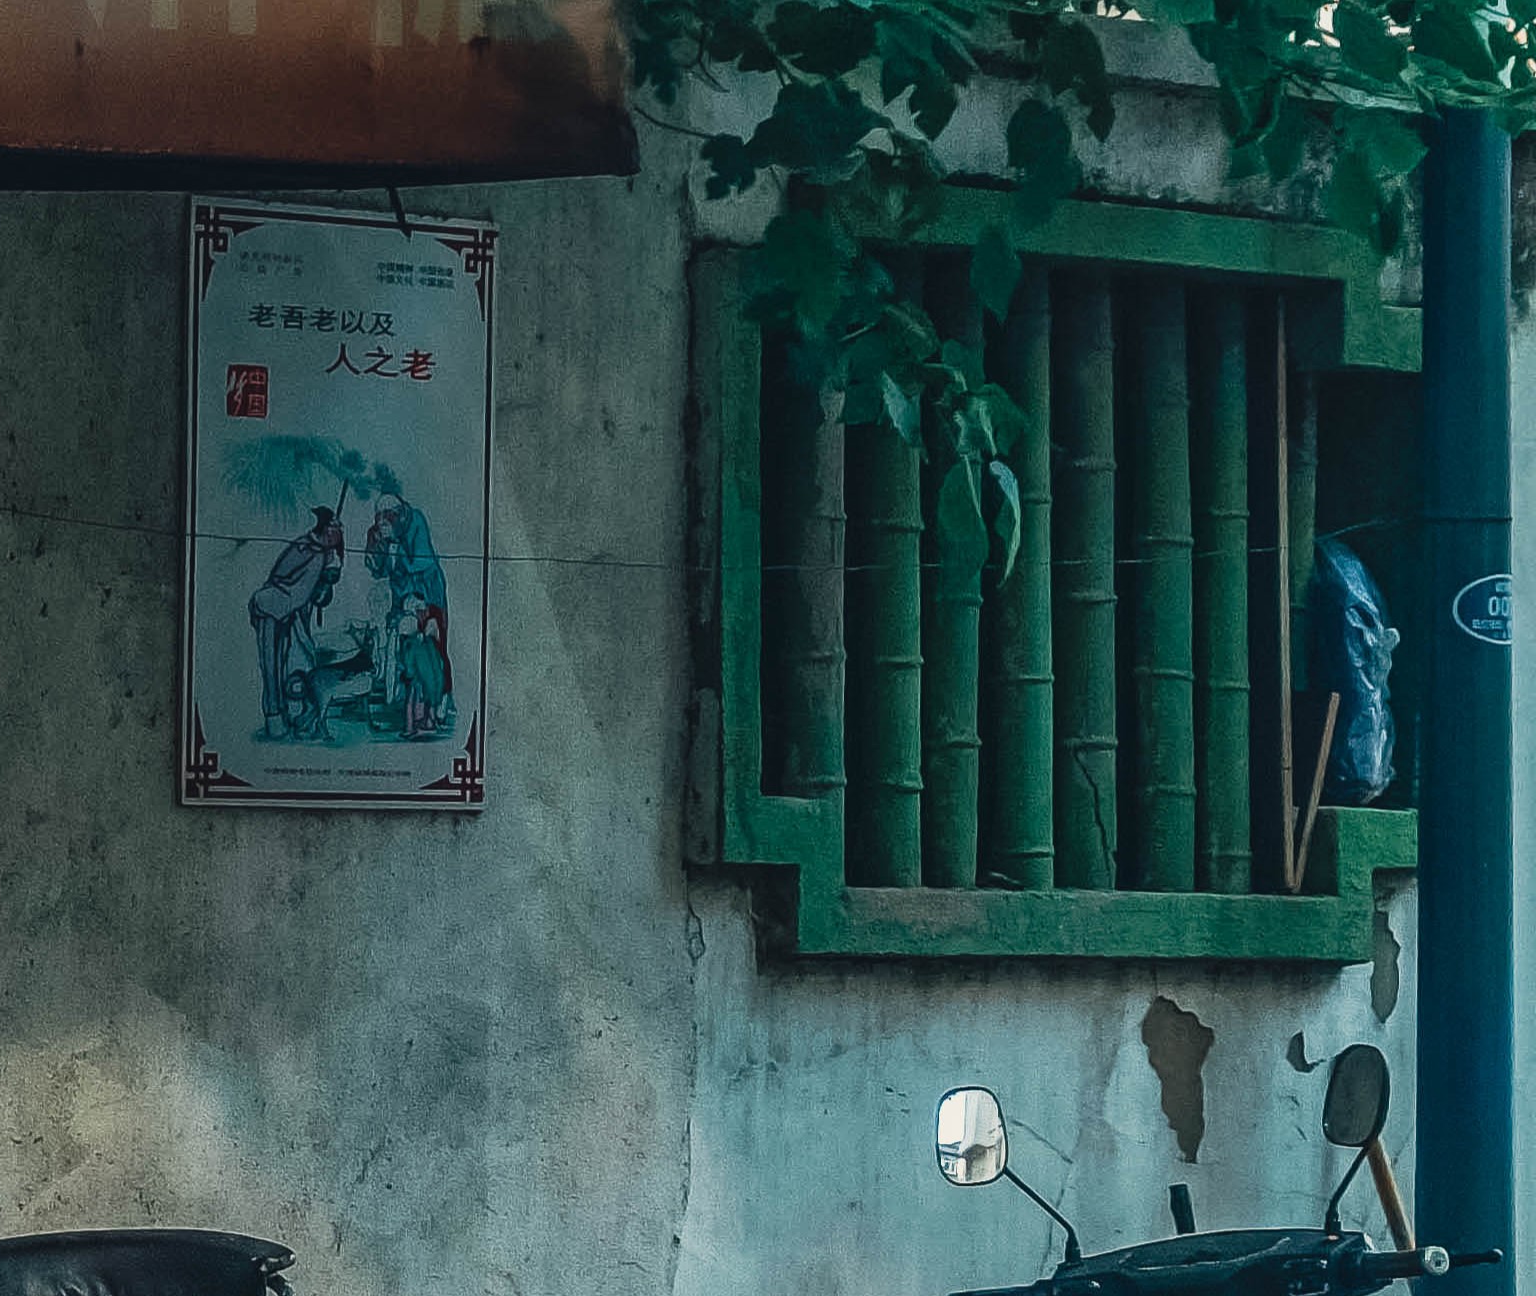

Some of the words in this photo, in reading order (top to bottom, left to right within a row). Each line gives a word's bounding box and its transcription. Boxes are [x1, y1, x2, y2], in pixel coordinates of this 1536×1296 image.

[248, 303, 396, 337] 老吾老以及
[325, 342, 437, 381] 人之老
